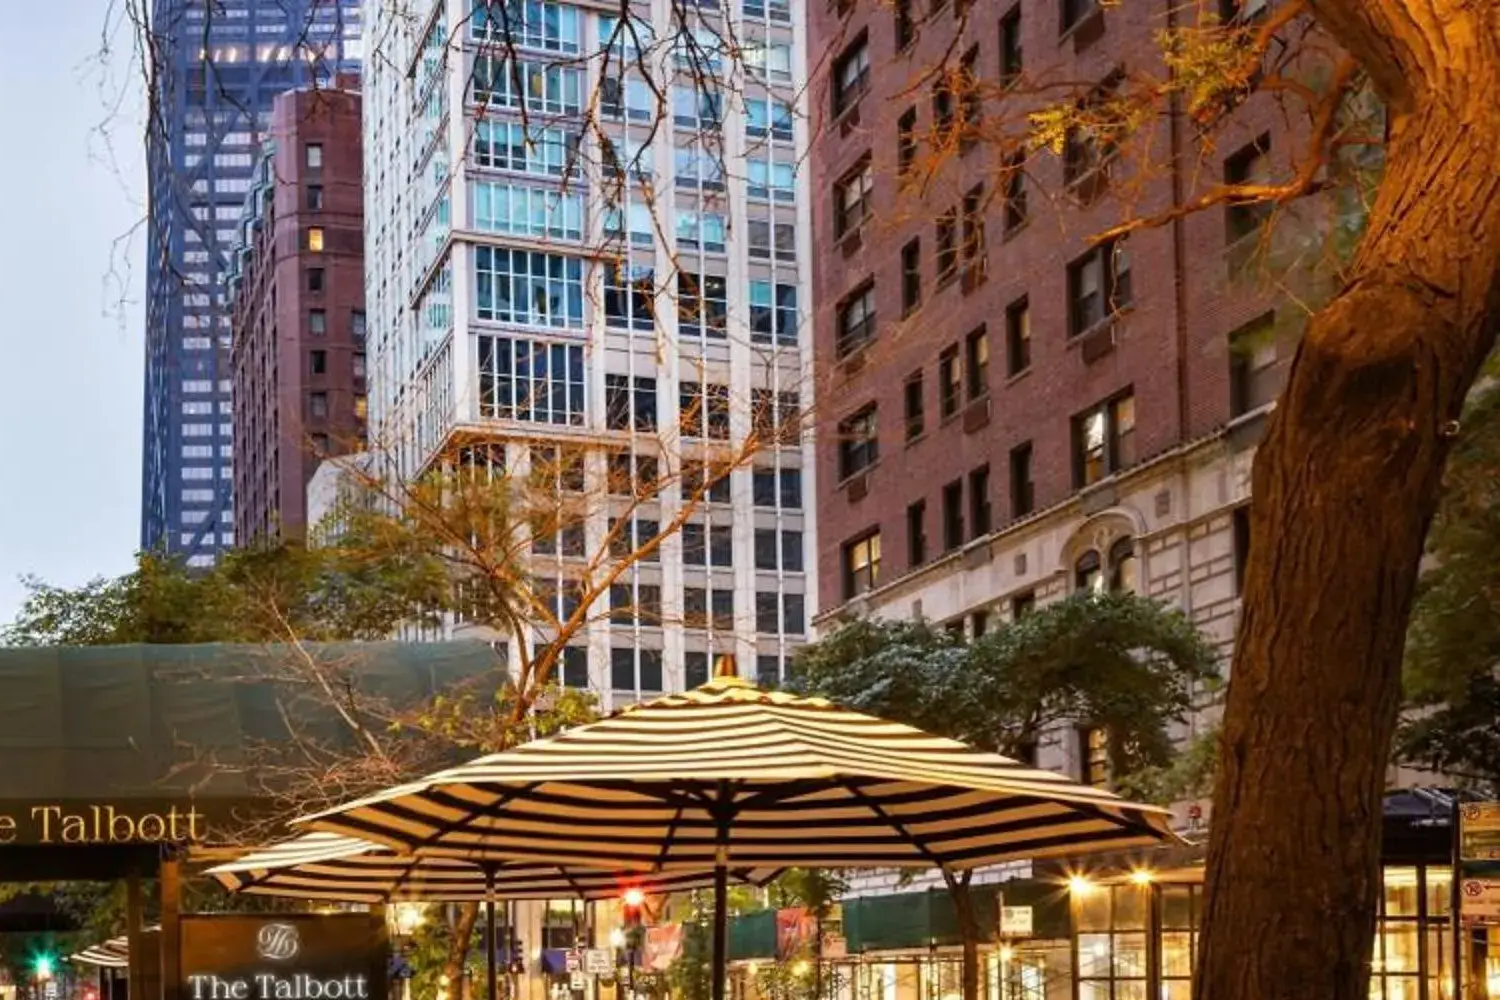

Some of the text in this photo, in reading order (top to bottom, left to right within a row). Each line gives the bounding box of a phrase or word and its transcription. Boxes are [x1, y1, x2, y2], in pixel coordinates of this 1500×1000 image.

[31, 804, 207, 843] Talbott
[188, 973, 369, 1000] The Talbott
